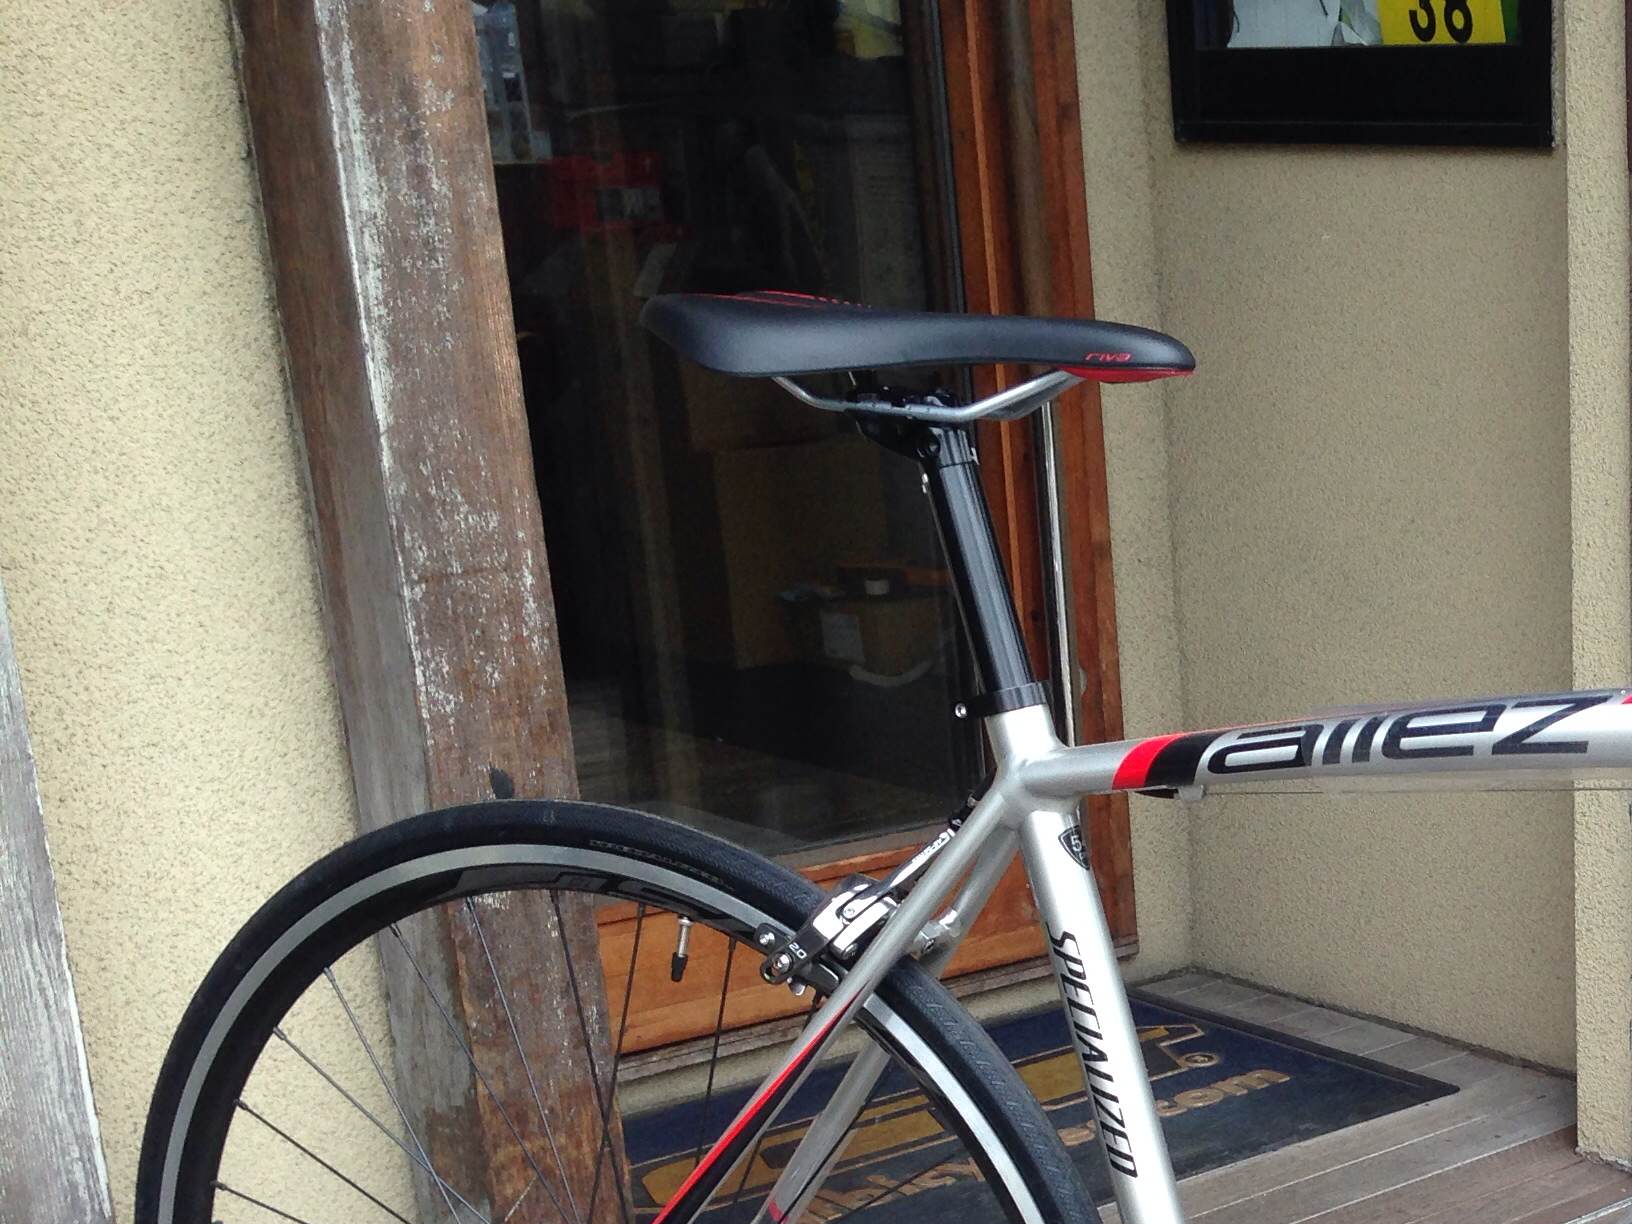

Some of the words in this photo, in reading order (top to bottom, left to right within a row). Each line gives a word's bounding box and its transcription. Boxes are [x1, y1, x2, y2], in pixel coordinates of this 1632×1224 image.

[1083, 350, 1132, 362] riva
[1206, 694, 1613, 775] allez
[1046, 922, 1138, 1179] SPECIALIZED
